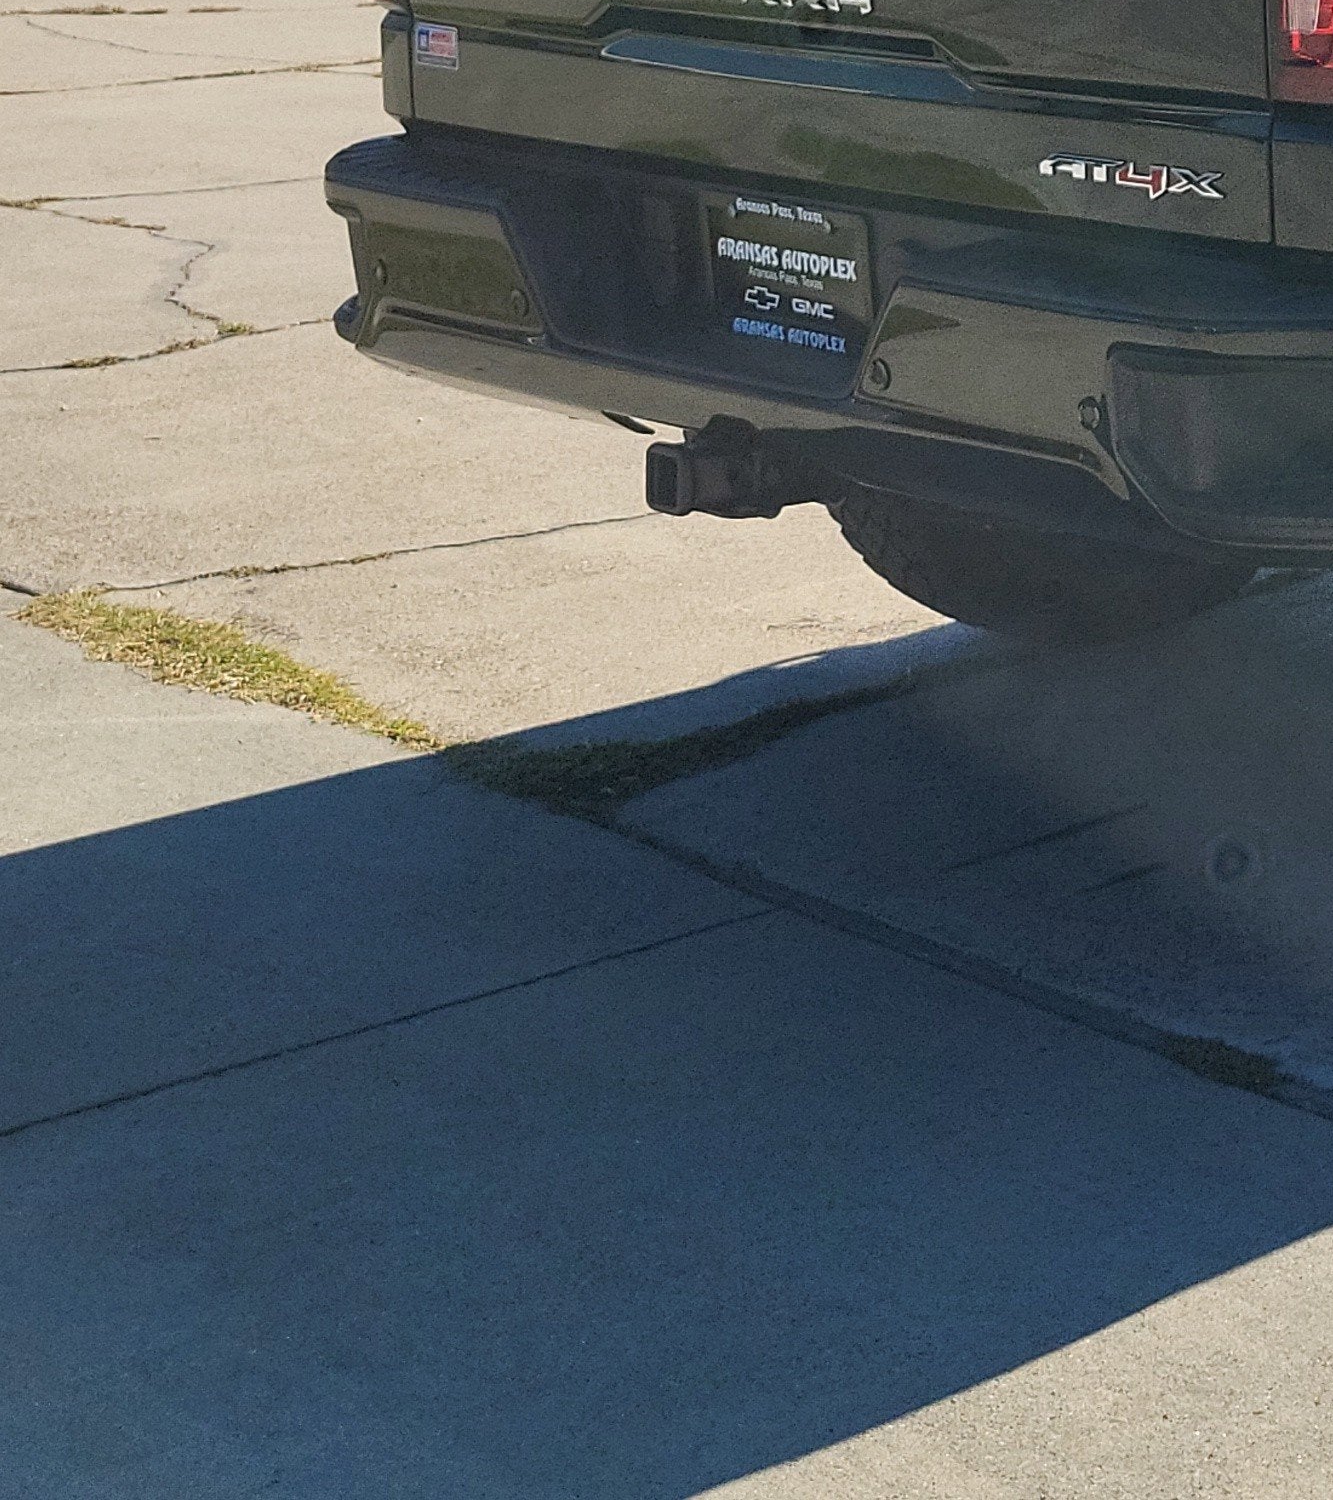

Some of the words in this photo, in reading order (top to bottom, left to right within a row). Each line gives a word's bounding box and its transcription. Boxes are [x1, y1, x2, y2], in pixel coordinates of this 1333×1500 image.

[1039, 152, 1225, 200] AT4X
[717, 237, 779, 267] ARANSAS
[781, 249, 857, 282] AUTOPLEX
[791, 297, 835, 320] GMC
[732, 317, 786, 341] ARANSAS
[787, 327, 846, 353] AUTOPLEX
